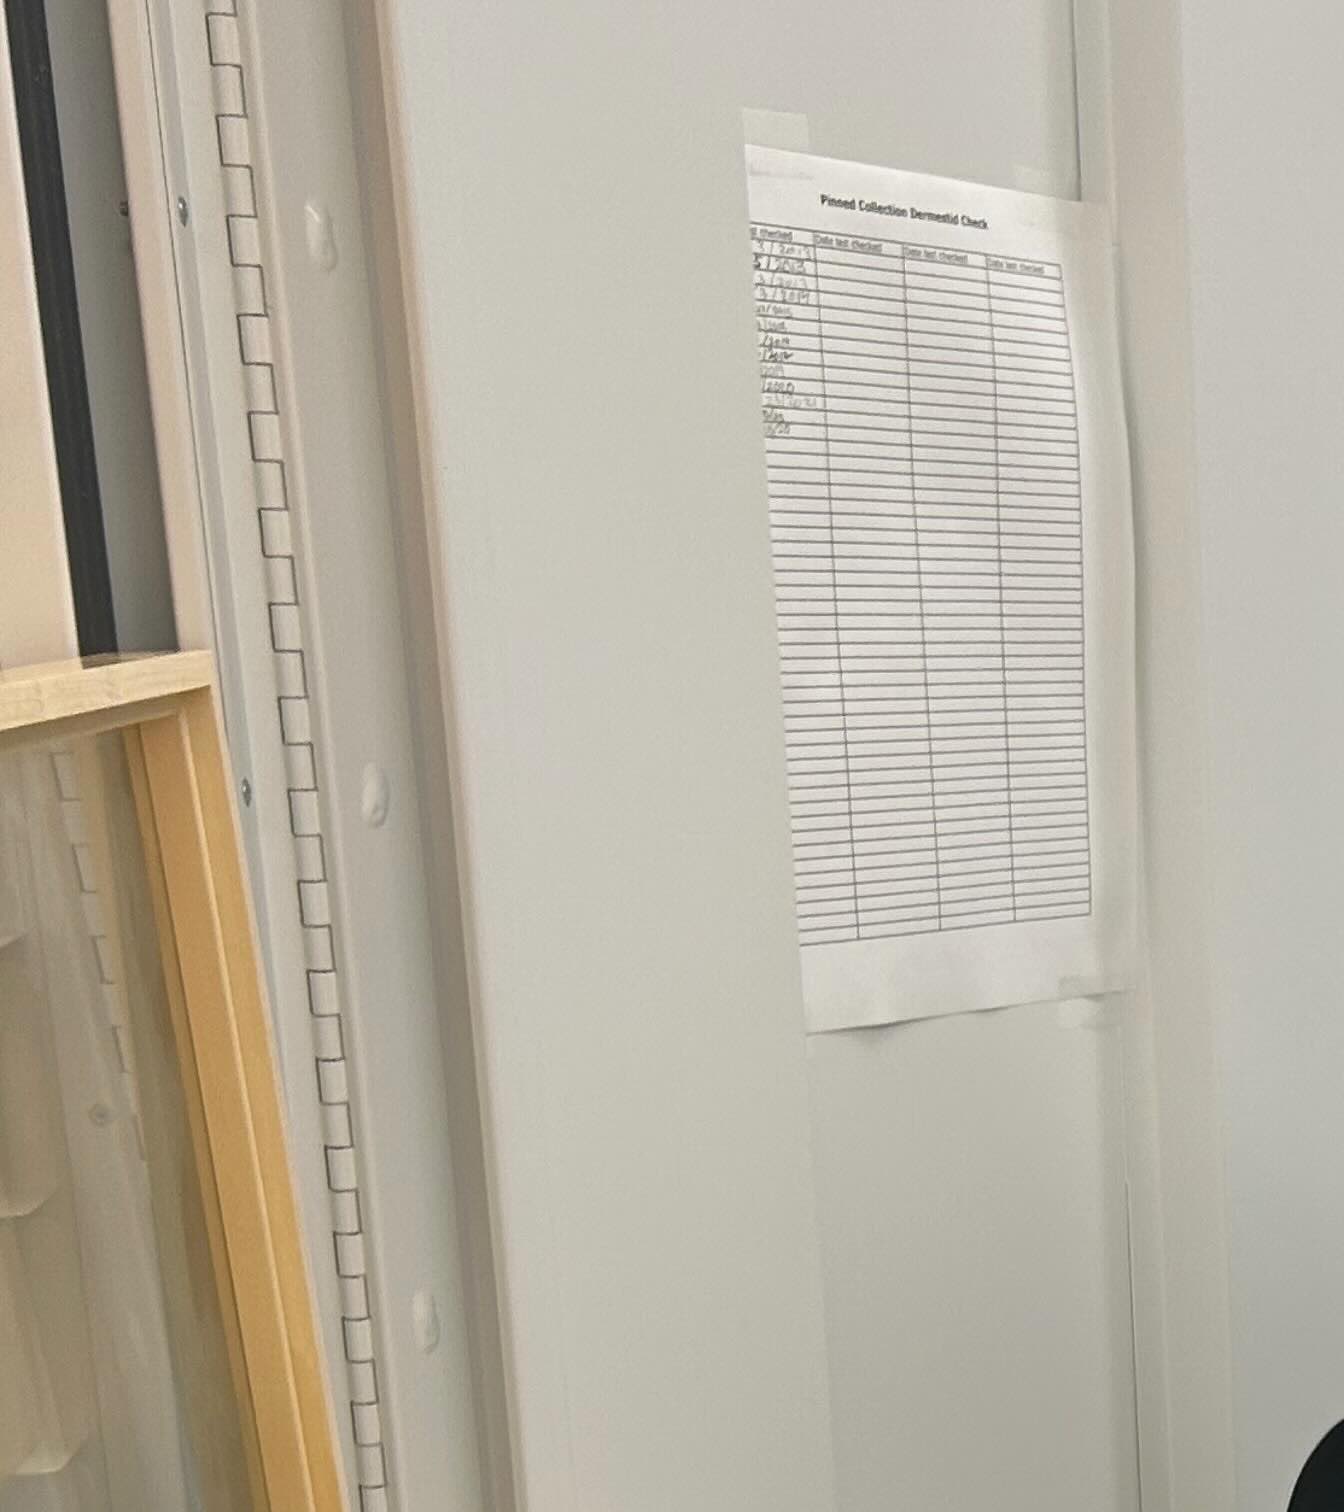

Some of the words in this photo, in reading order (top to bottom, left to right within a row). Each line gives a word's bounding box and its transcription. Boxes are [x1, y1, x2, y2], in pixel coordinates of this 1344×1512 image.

[820, 194, 856, 211] Pinned
[858, 199, 908, 218] Collection
[910, 207, 959, 225] Dermestid
[960, 215, 988, 229] Check
